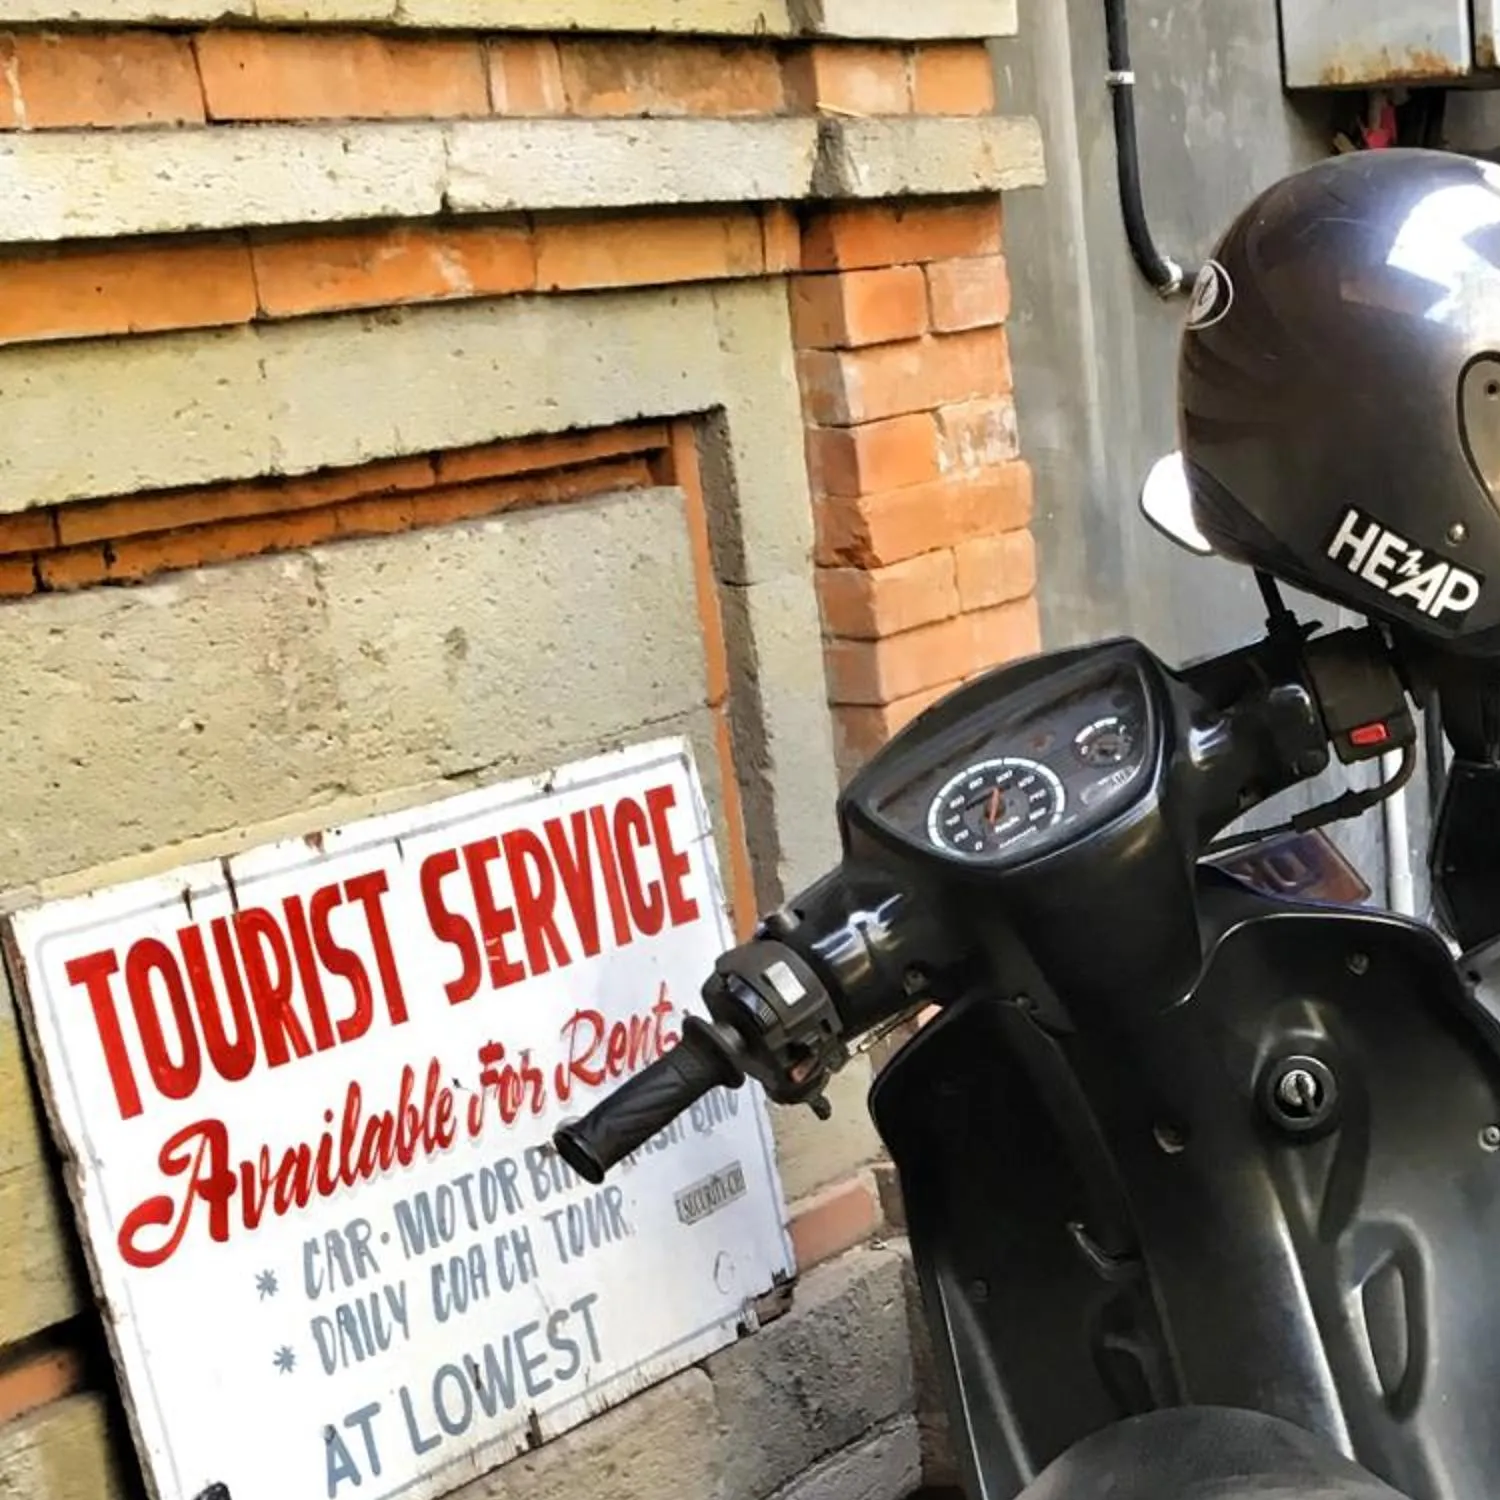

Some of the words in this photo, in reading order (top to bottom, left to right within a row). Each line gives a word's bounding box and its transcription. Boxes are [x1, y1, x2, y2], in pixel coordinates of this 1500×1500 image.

[65, 869, 408, 1120] TOURIST
[420, 784, 700, 1006] SERVICE
[118, 1056, 456, 1269] Available
[468, 1040, 545, 1136] For
[393, 1157, 524, 1260] MOTOR
[310, 1280, 409, 1375] DAILY
[430, 1225, 538, 1323] COACH
[324, 1402, 383, 1500] AT
[399, 1293, 602, 1454] LOWEST
